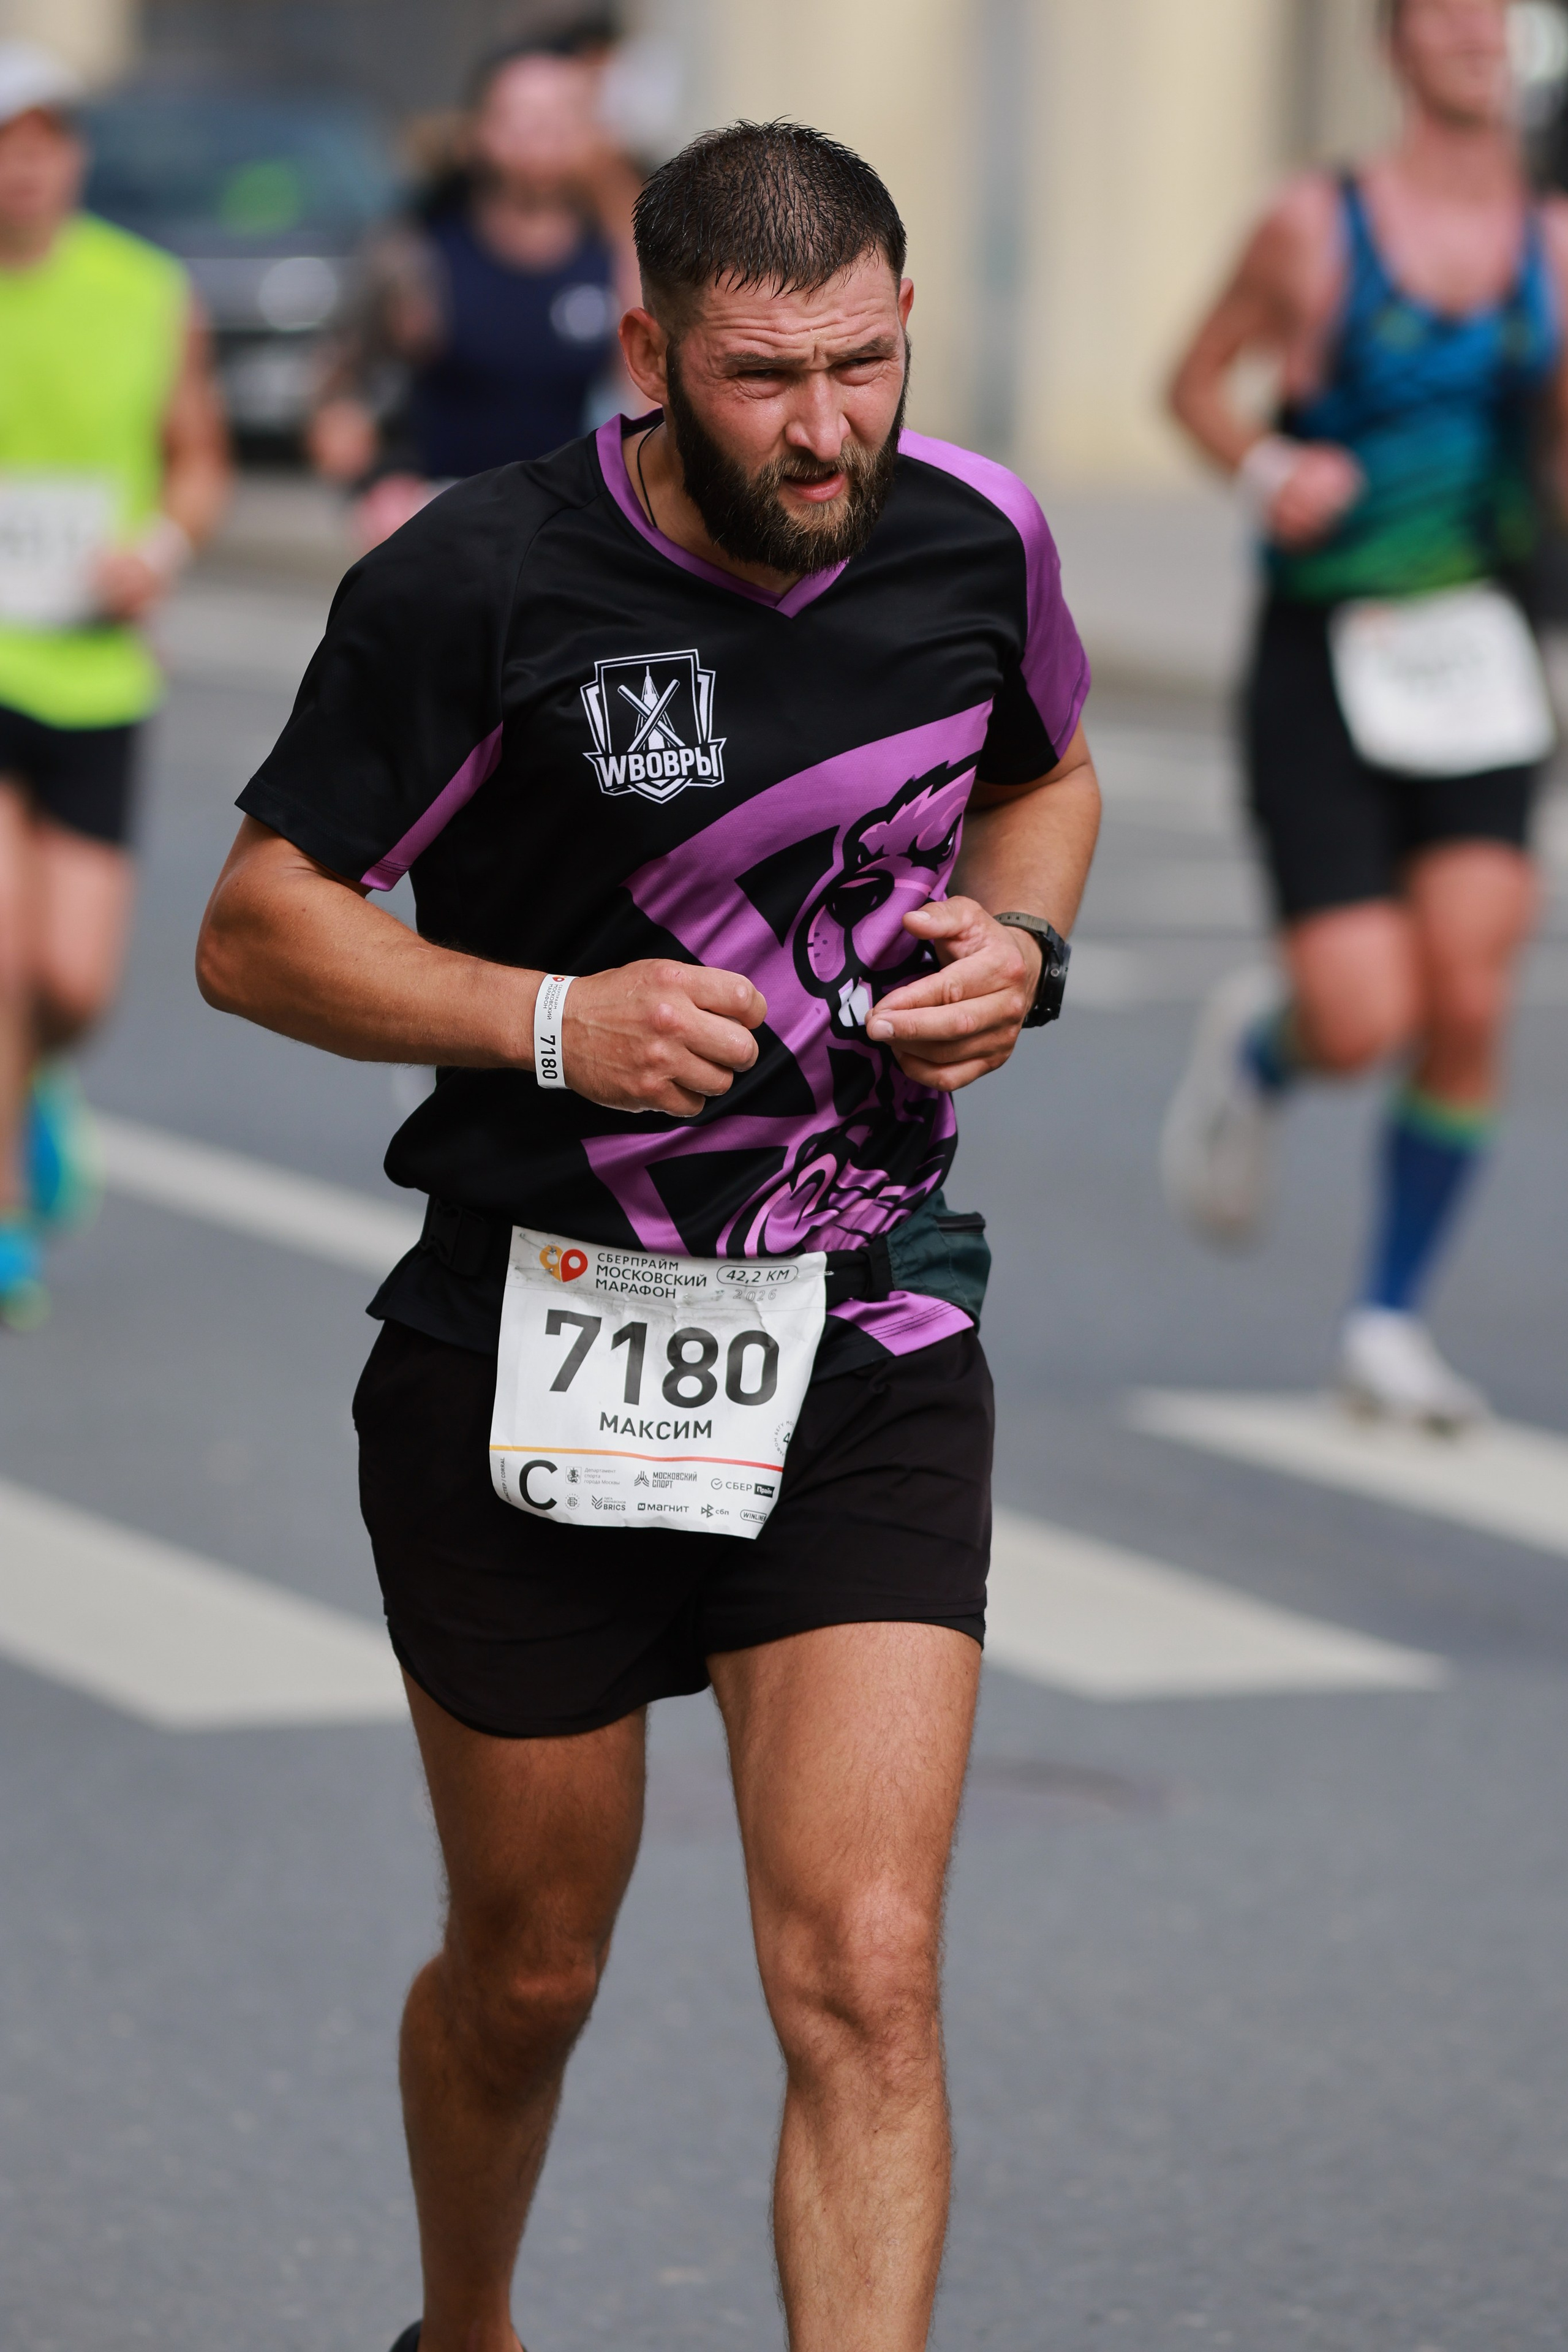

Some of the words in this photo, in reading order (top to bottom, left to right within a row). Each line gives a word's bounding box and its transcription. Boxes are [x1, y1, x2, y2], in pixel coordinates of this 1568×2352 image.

[543, 984, 553, 1009] МАРАФОН
[547, 984, 558, 1020] МОСКОВСКИЙ
[540, 1035, 558, 1079] 7180
[597, 1253, 679, 1271] СБЕРПРАЙМ
[596, 1264, 707, 1287] МОСКОВСКИЙ
[726, 1270, 761, 1283] 42,2
[766, 1269, 790, 1282] КМ
[595, 1278, 676, 1299] МАРАФОН
[733, 1288, 777, 1302] 2026
[545, 1308, 780, 1408] 7180
[599, 1411, 713, 1440] МАКСИМ
[652, 1471, 697, 1482] МОСКОВСКИЙ
[652, 1479, 673, 1488] СПОРТ
[725, 1481, 752, 1491] СБЕР
[647, 1503, 690, 1513] магнит
